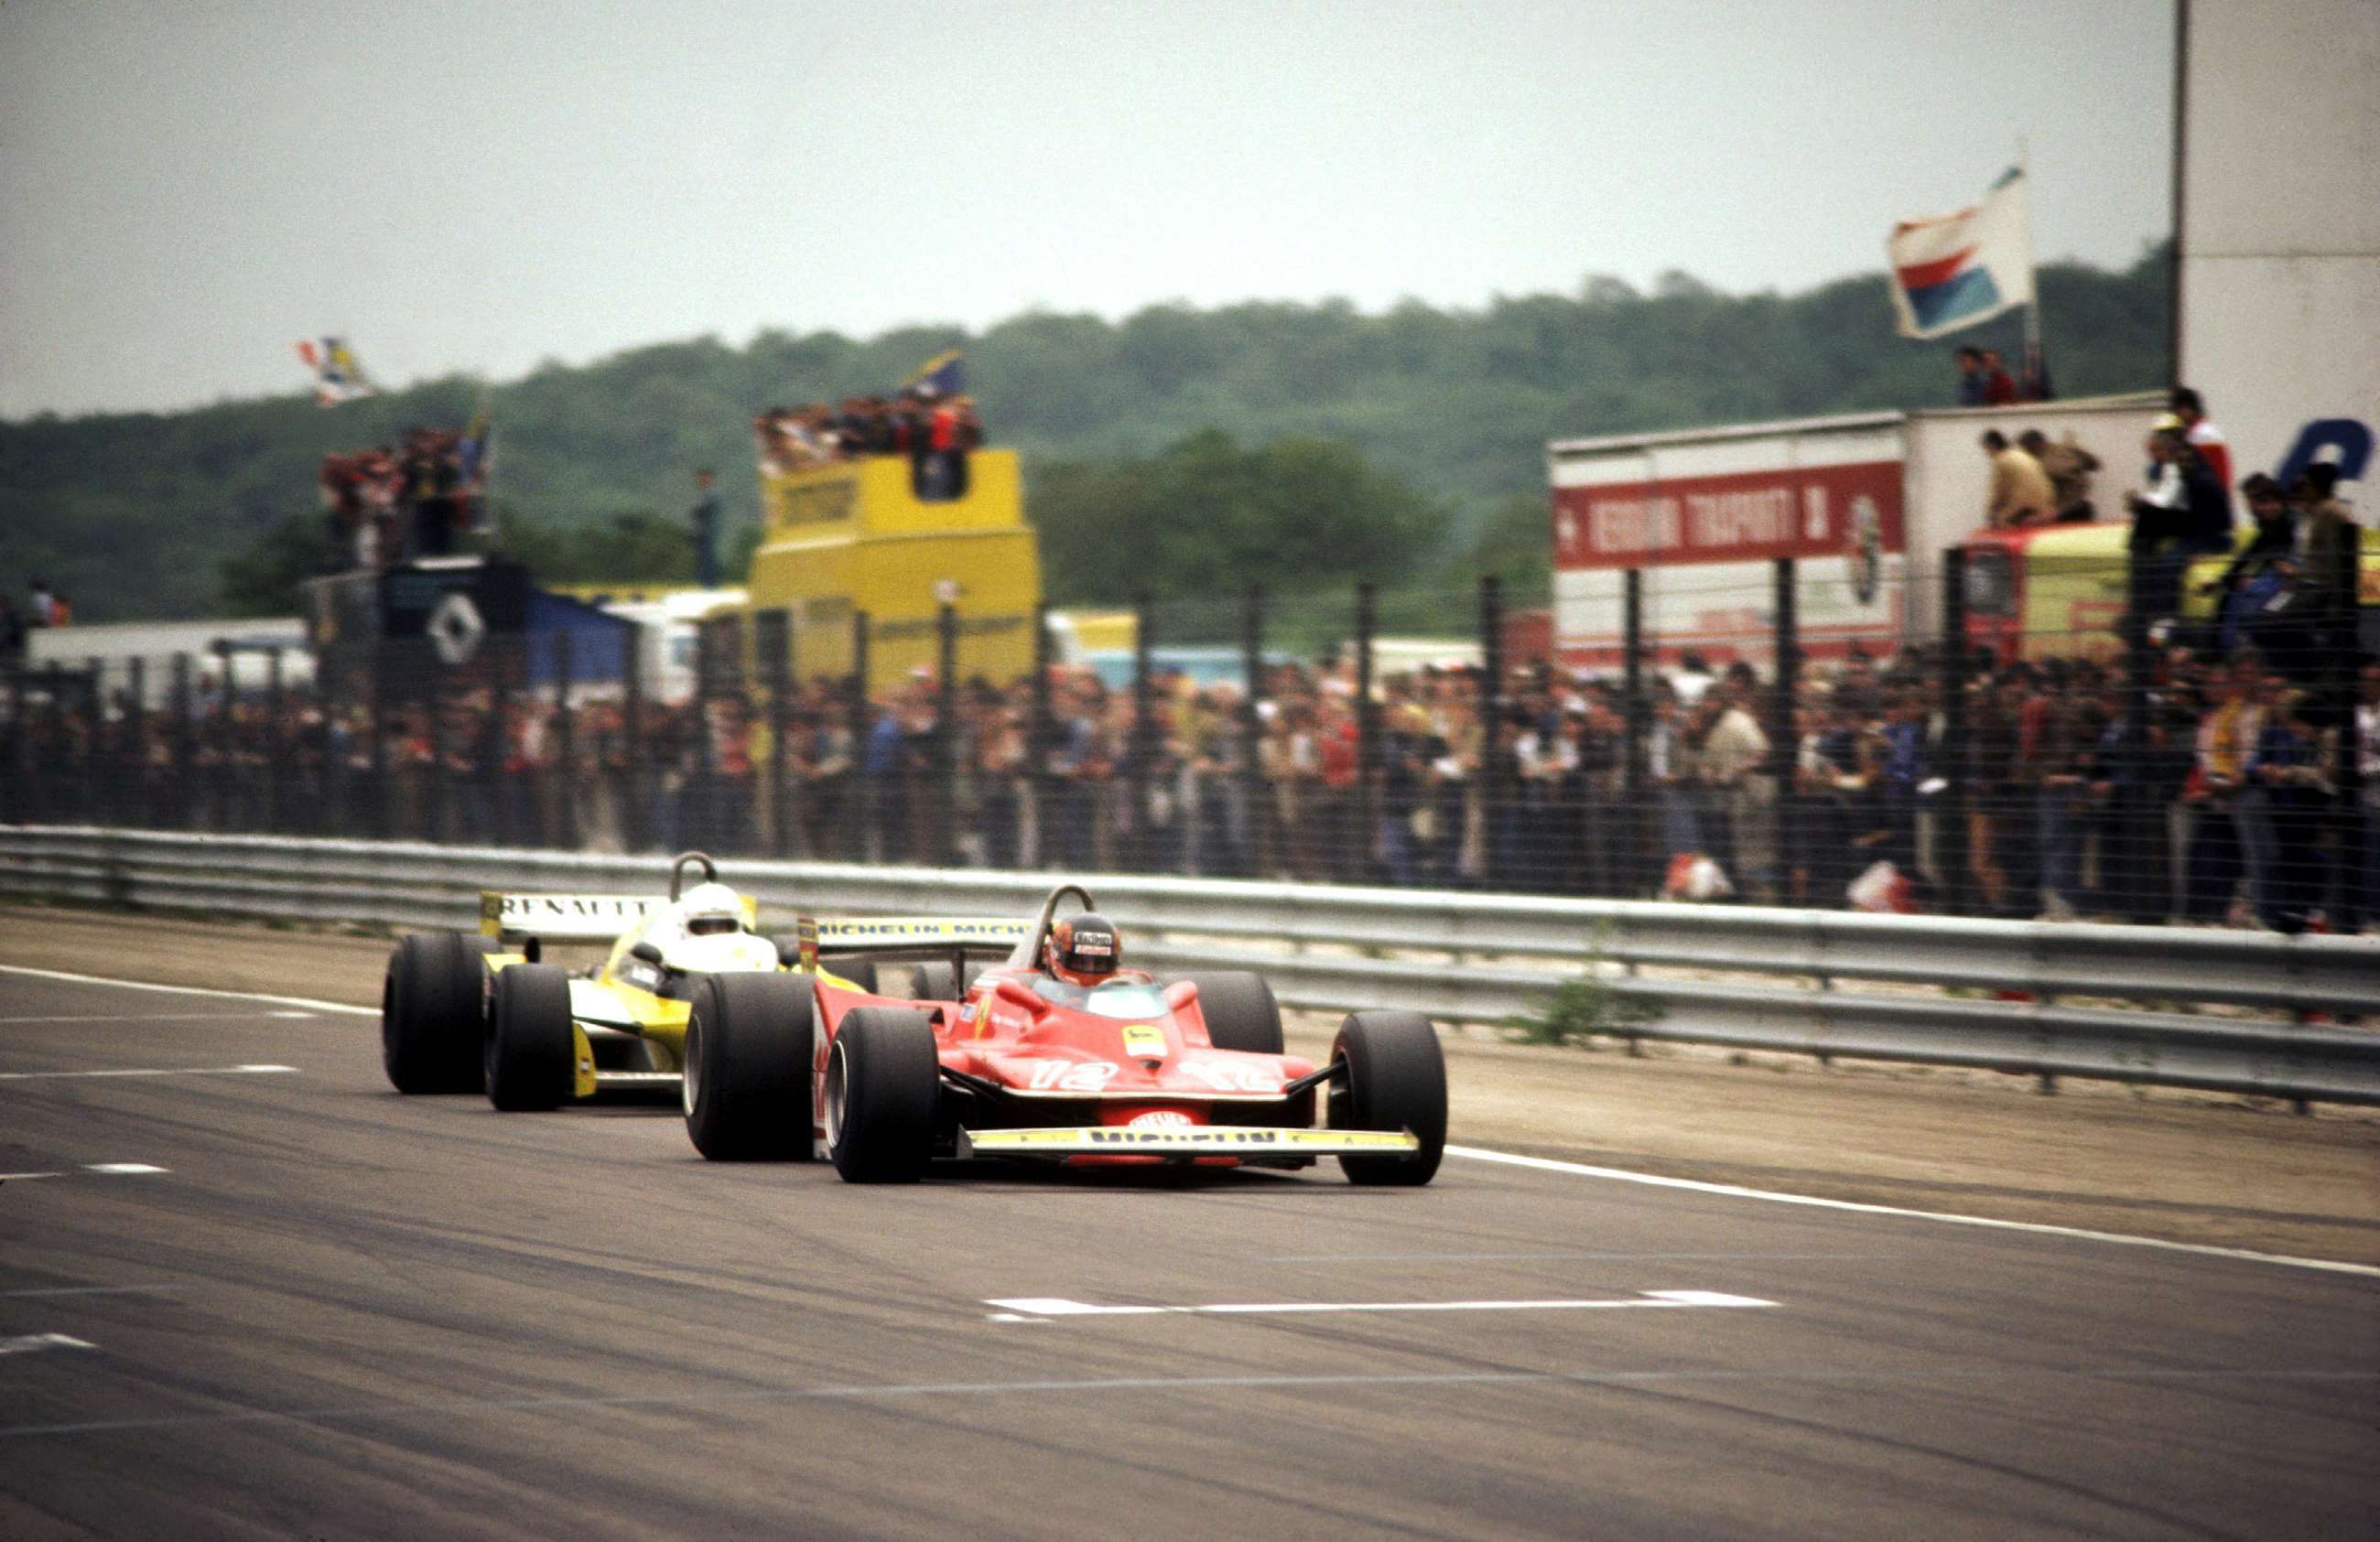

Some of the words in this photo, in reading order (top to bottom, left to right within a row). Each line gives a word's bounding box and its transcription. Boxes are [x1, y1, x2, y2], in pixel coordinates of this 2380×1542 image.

[817, 923, 940, 936] MICHELIN
[954, 923, 1031, 935] MICH
[1029, 1059, 1120, 1091] 12
